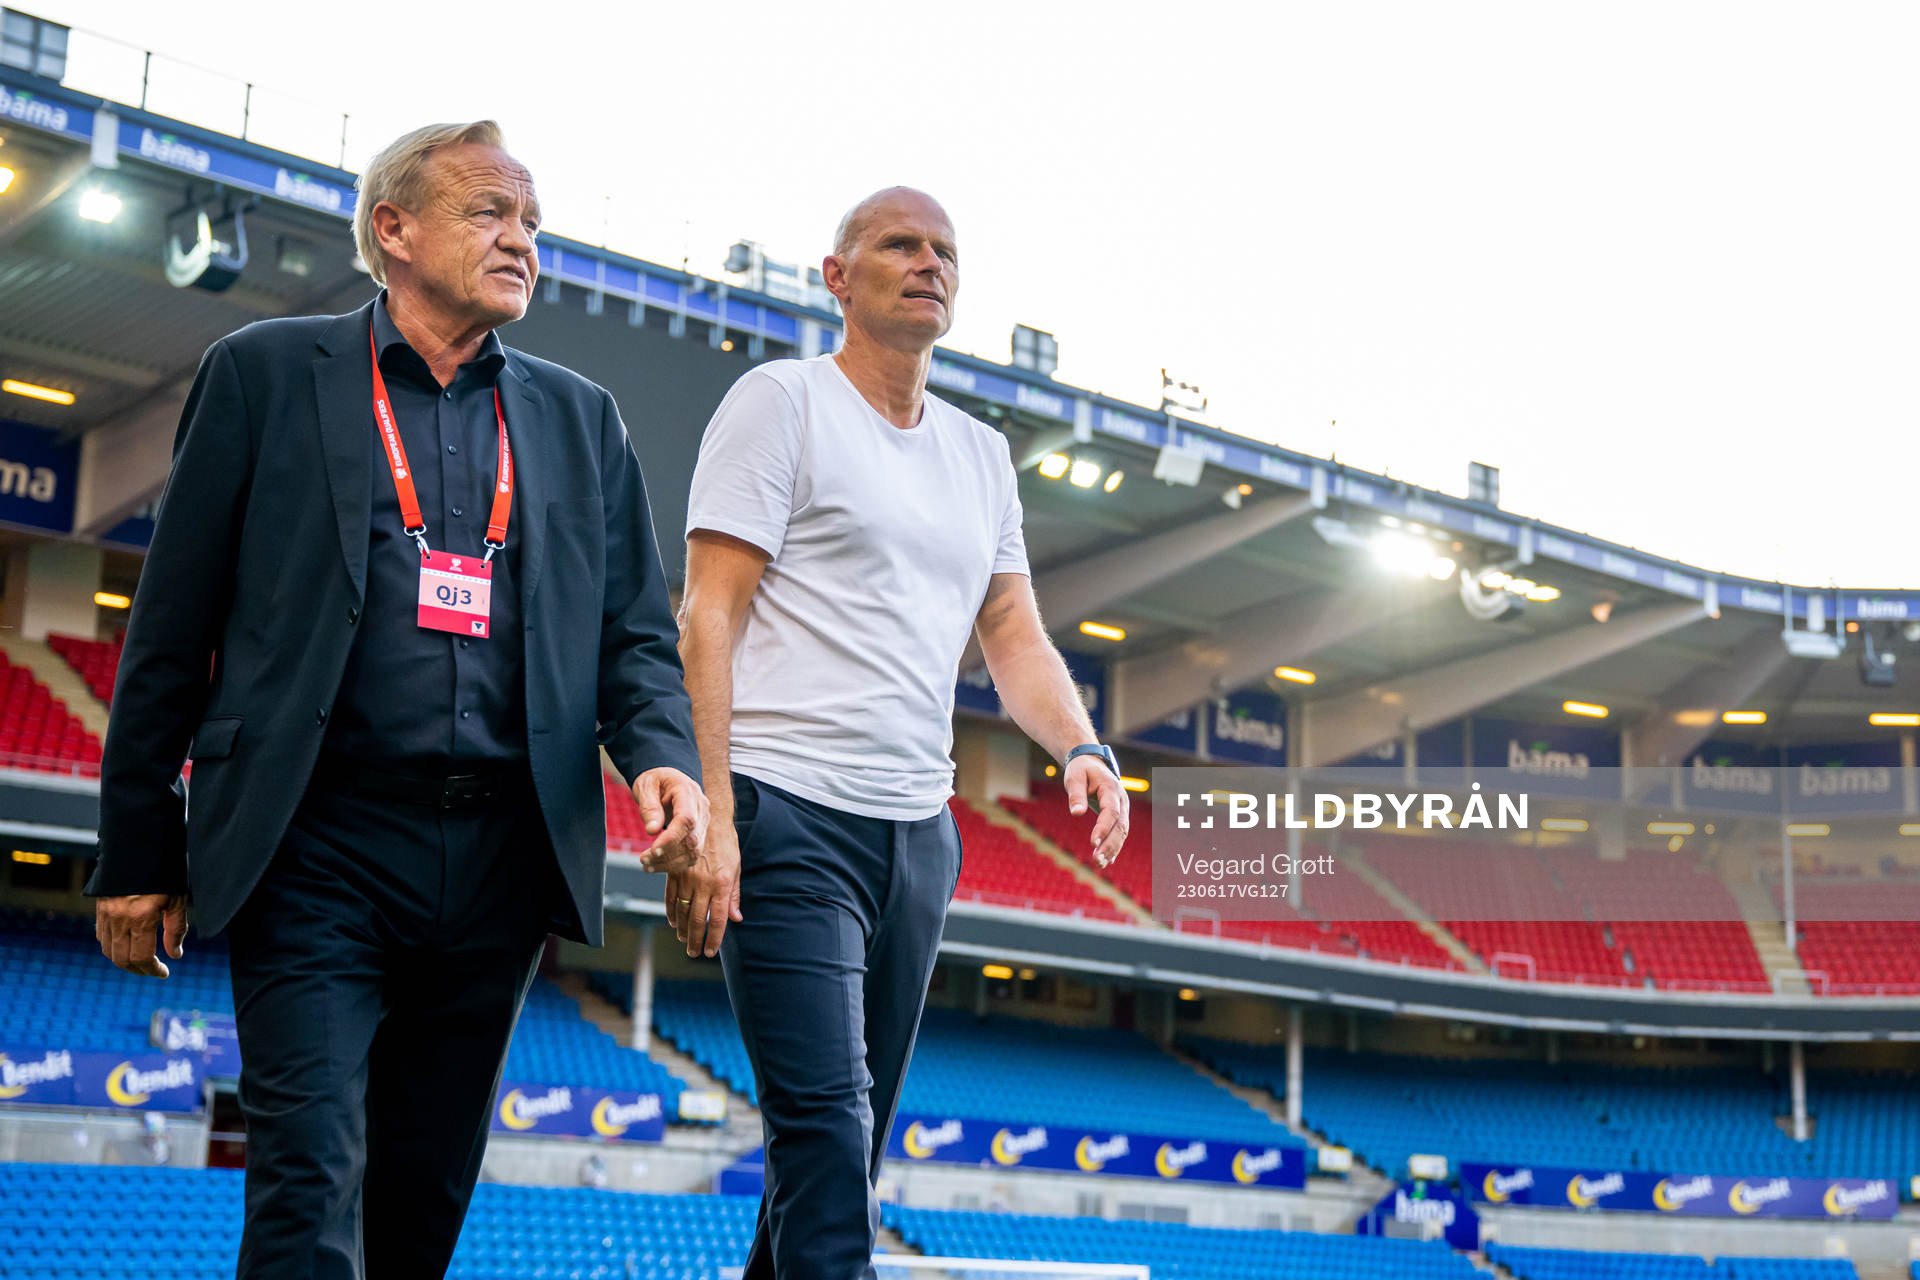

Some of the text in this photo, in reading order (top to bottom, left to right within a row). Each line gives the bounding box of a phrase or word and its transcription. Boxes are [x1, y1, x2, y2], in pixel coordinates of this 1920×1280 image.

[436, 585, 472, 606] Qj3
[1508, 741, 1590, 780] bama
[1692, 757, 1773, 795] bama
[1802, 764, 1891, 796] bama
